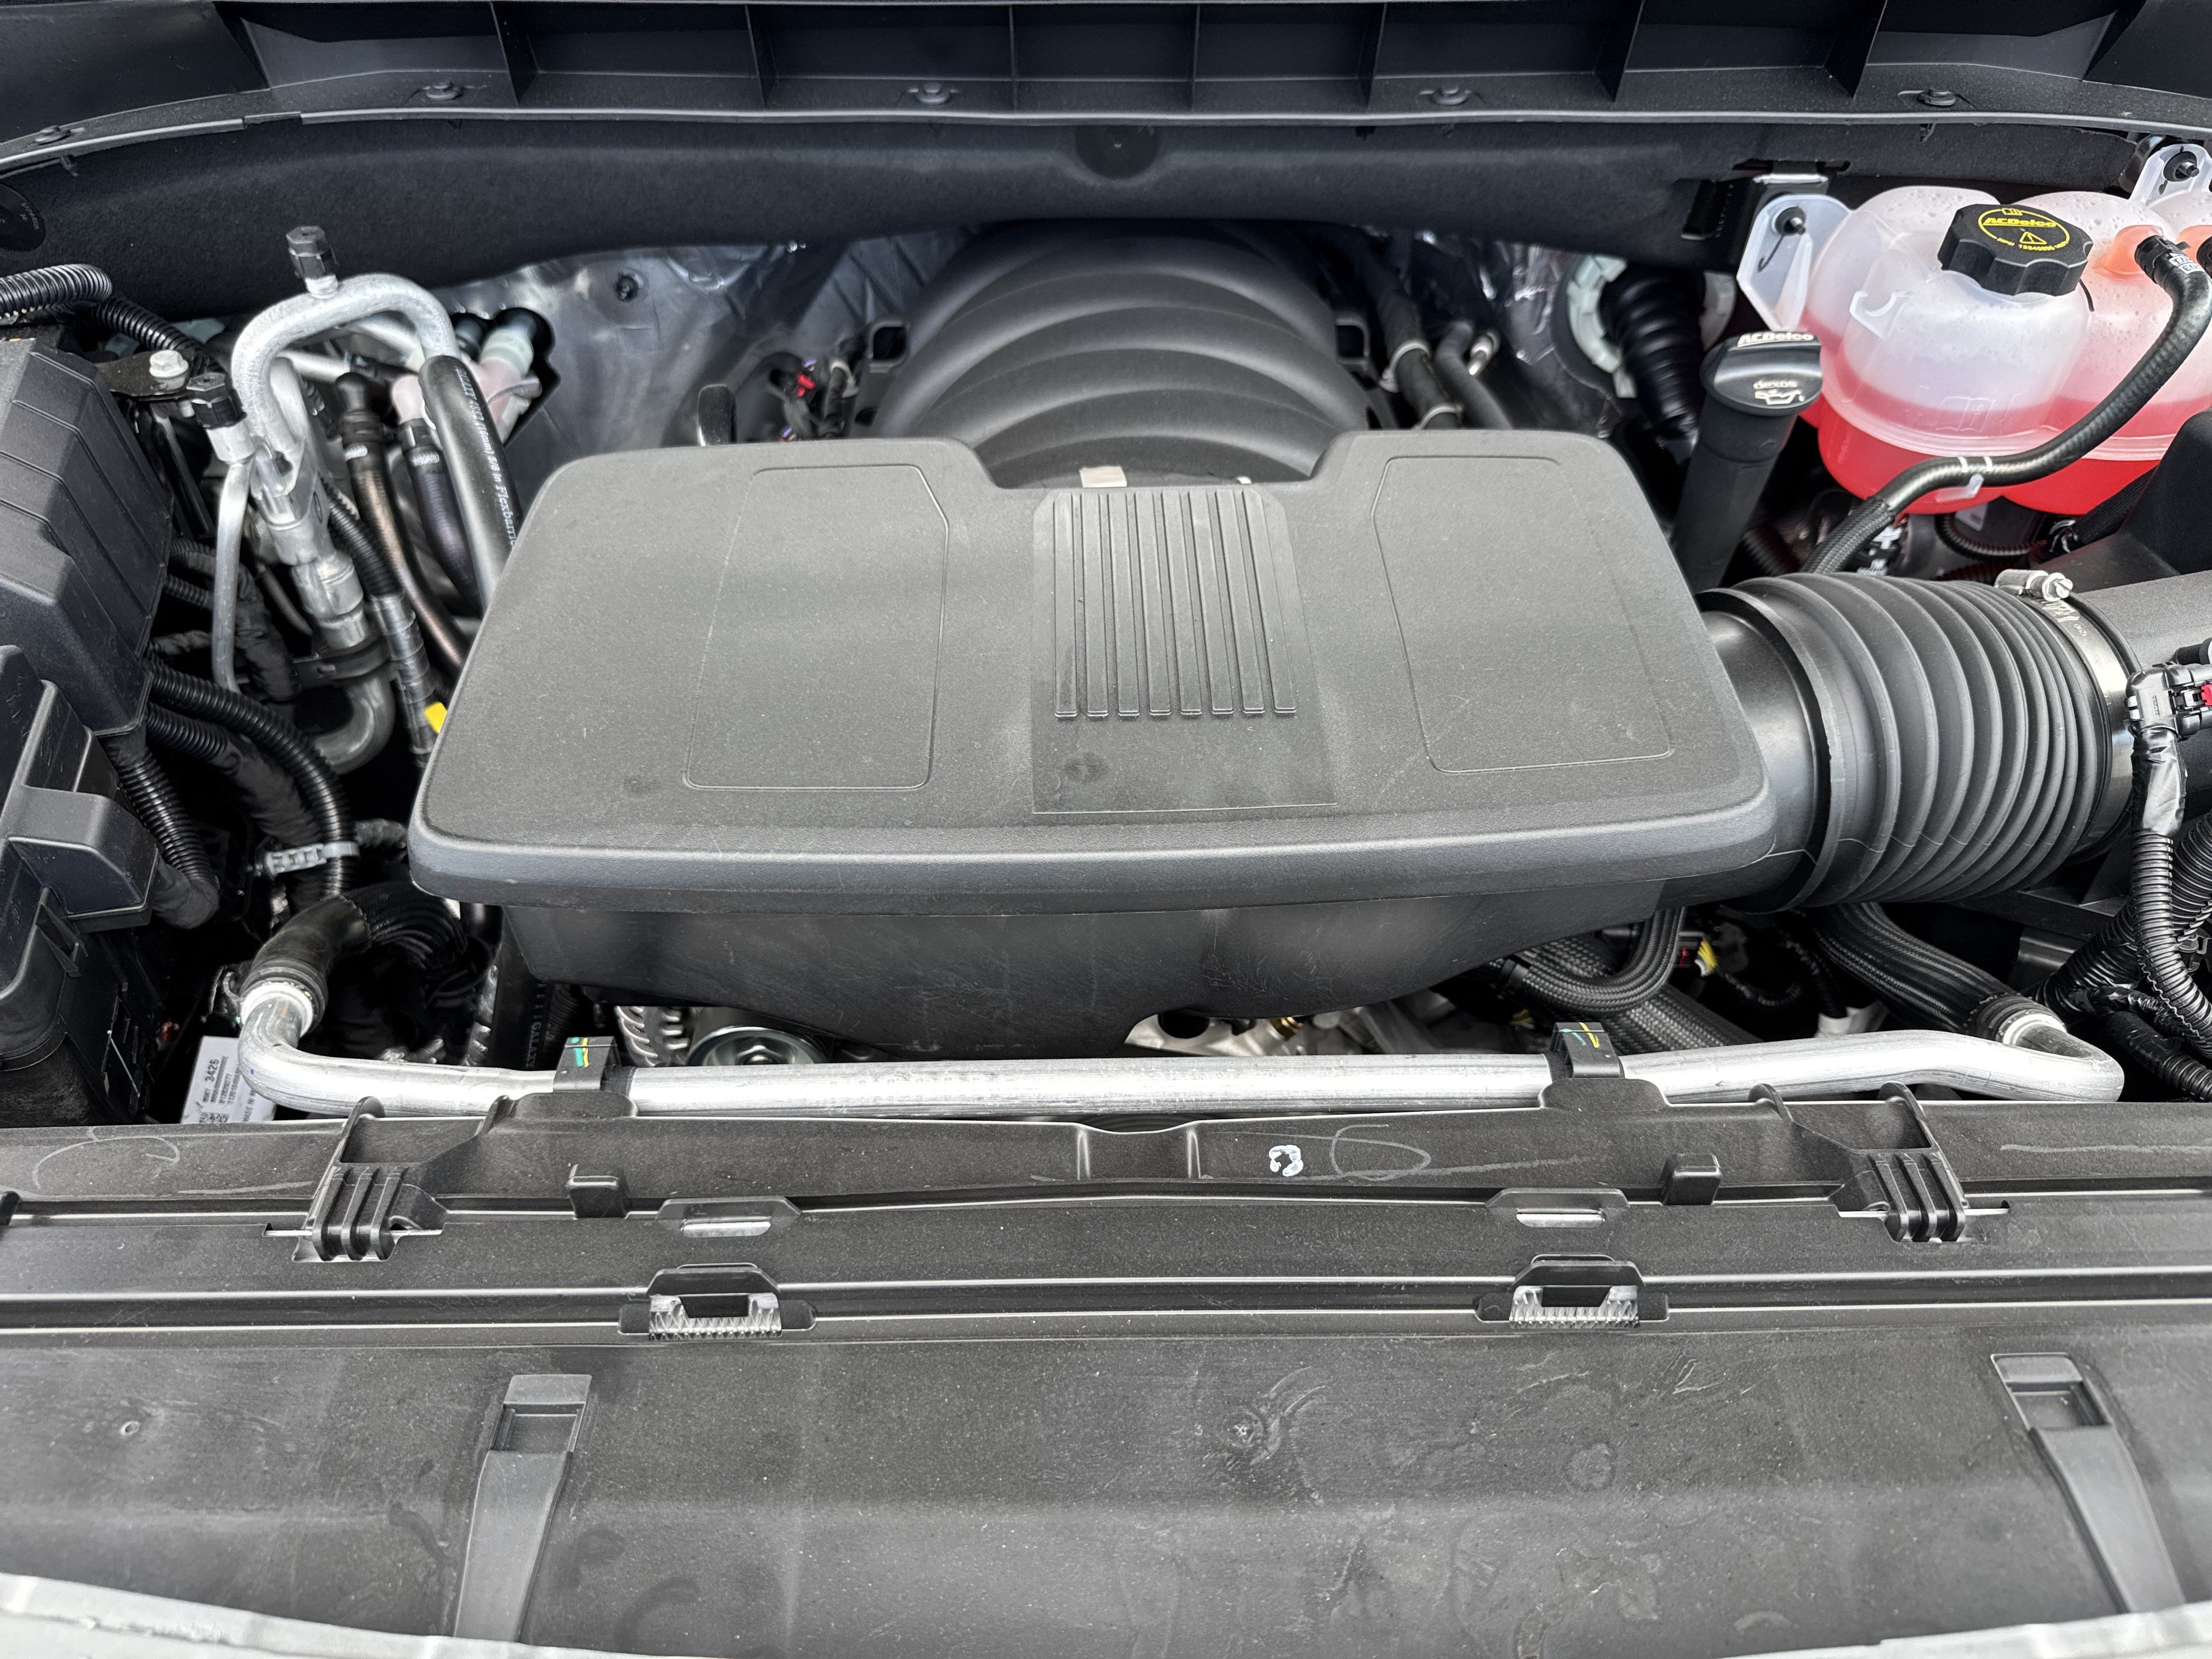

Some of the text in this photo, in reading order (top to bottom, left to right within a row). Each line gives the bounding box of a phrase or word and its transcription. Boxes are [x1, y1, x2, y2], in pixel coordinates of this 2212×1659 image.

[1982, 217, 2057, 228] ACDelco
[1737, 332, 1814, 347] ACDelco
[1753, 379, 1798, 390] dexos
[488, 455, 500, 471] 5/8
[493, 473, 502, 482] in
